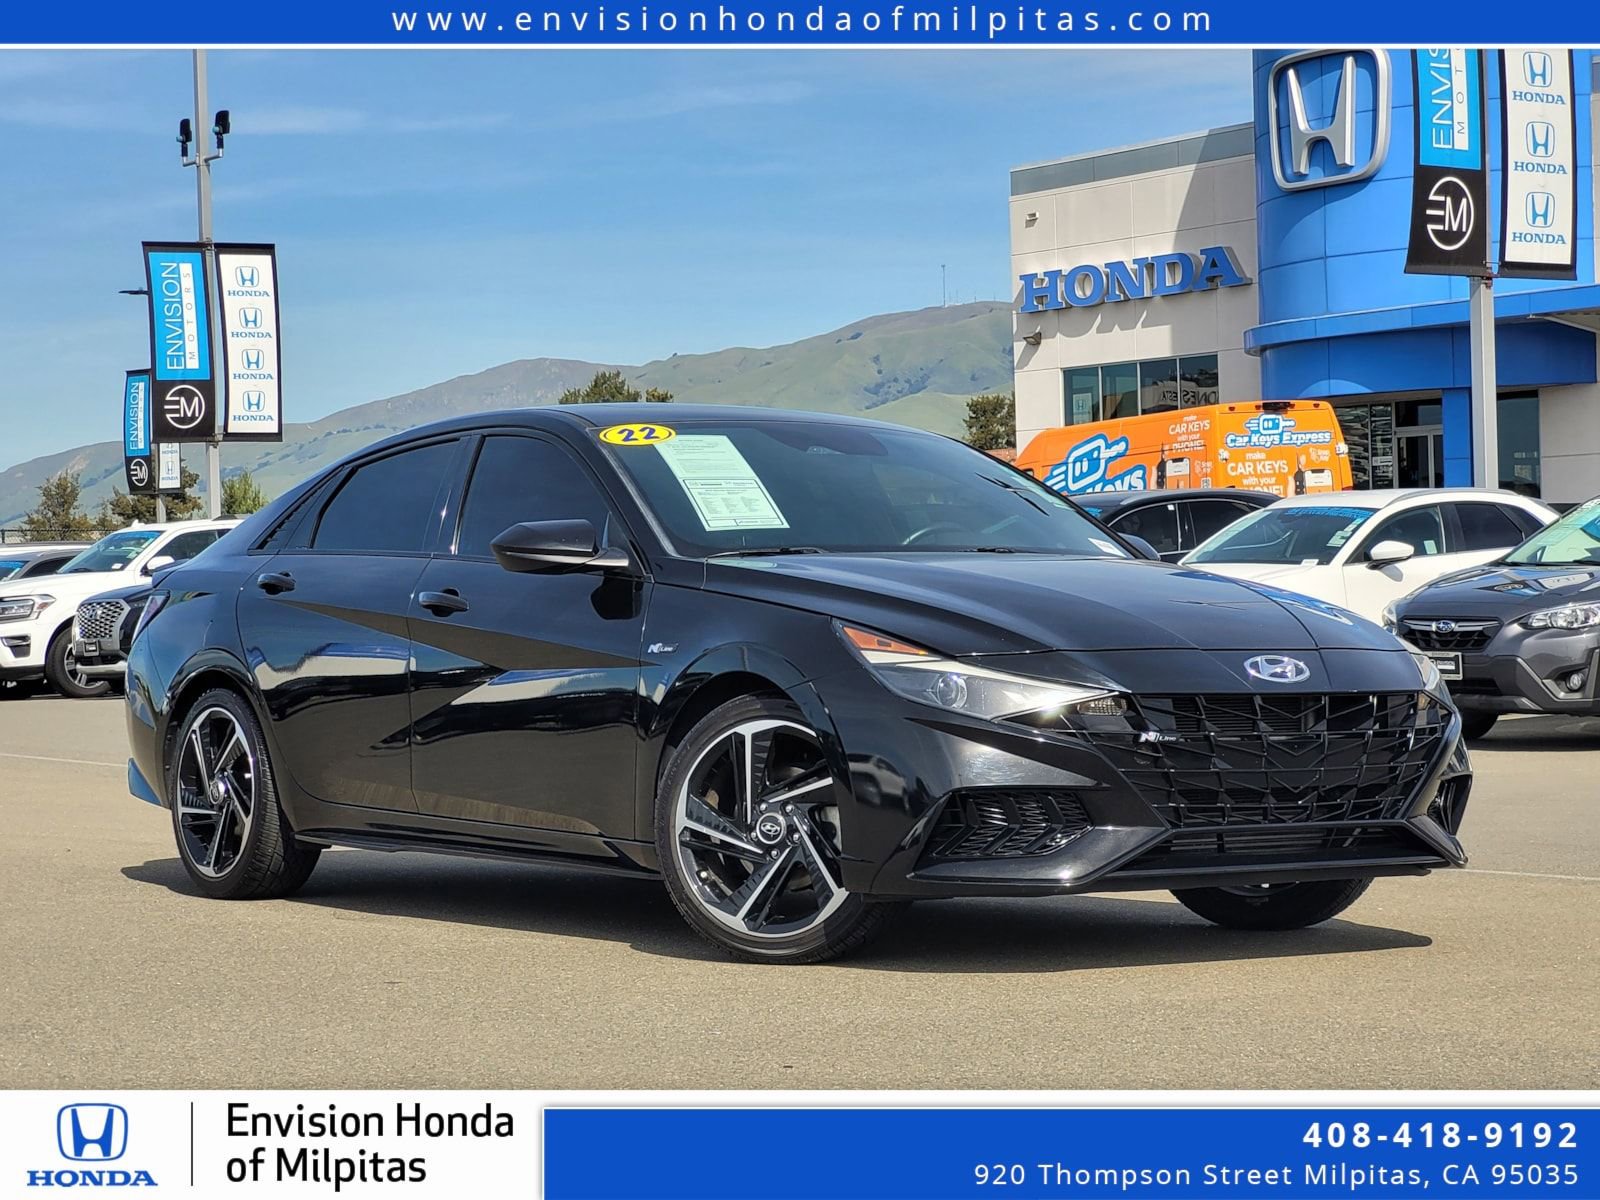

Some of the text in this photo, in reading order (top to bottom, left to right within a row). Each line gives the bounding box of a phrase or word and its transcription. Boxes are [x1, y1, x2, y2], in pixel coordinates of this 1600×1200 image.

[1454, 49, 1465, 135] MOT
[1512, 90, 1566, 105] HONDA
[1513, 161, 1568, 175] HONDA
[1512, 231, 1566, 245] HONDA
[1019, 246, 1246, 313] HONDA
[227, 290, 270, 298] HONDA
[160, 262, 185, 370] ENVISION
[183, 272, 196, 361] MOTORS
[231, 331, 273, 339] HONDA
[232, 373, 274, 381] HONDA
[129, 383, 139, 450] ENVISION
[232, 414, 274, 422] HONDA
[618, 426, 661, 442] 22
[1168, 419, 1211, 435] CAR KEYS
[1226, 431, 1332, 448] Car Keys Express
[1245, 451, 1266, 460] make
[1227, 461, 1255, 476] CAR
[1256, 459, 1289, 474] KEYS
[1242, 476, 1276, 487] with your
